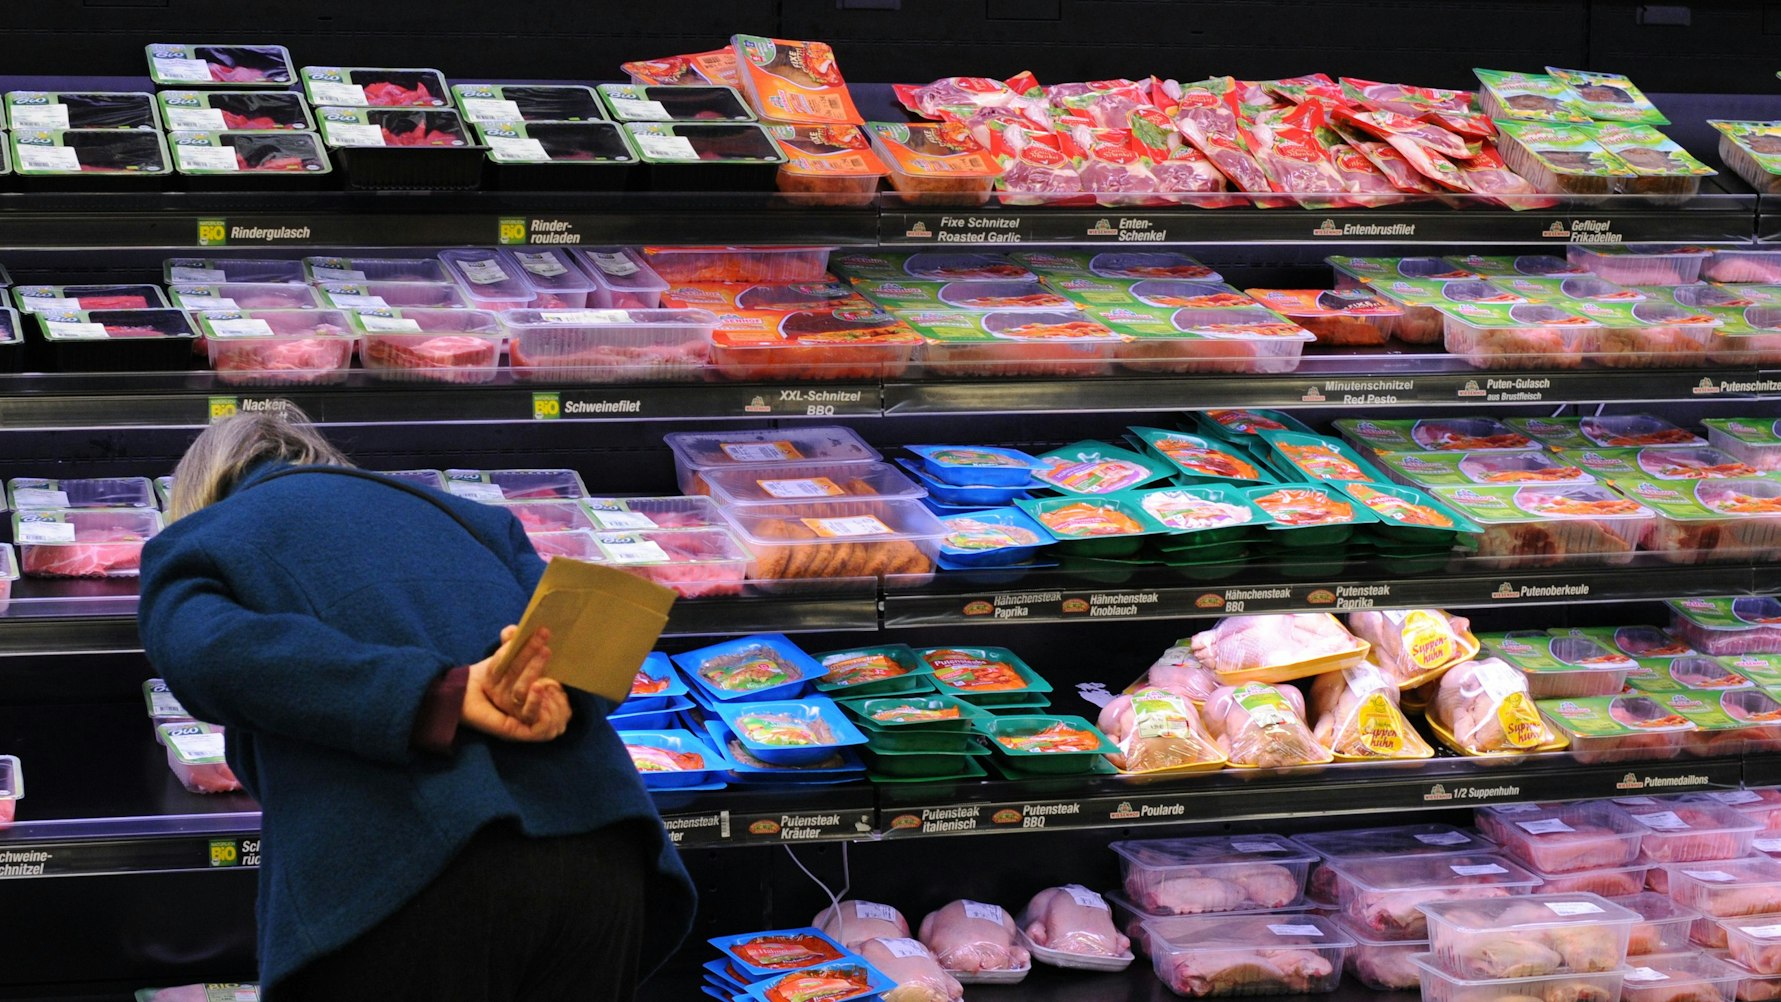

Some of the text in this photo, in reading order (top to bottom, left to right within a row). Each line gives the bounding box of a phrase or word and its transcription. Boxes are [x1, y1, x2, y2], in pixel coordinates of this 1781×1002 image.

[530, 220, 572, 231] Rinder-
[940, 217, 1020, 228] Fixe Schnitzel
[1119, 218, 1152, 229] Enten-
[1572, 220, 1611, 232] Geflügel
[231, 226, 310, 240] Rindergulasch
[1344, 224, 1416, 235] Entenbrustfilet
[530, 232, 580, 244] rouladen
[938, 231, 1020, 242] Roasted Garlic
[1118, 230, 1166, 242] Schenkel
[1570, 232, 1622, 242] Frikadellen
[1325, 380, 1414, 391] Minutenschnitzel
[1487, 378, 1550, 389] Puten-Gulasch
[780, 390, 861, 401] XXL-Schnitzel
[1344, 394, 1397, 404] Red Pesto
[1501, 392, 1542, 400] Brustfleisch
[242, 399, 291, 410] Nacken-
[564, 400, 641, 412] Schweinefilet
[806, 405, 834, 416] BBQ
[1225, 588, 1291, 600] Hähnchensteak
[1336, 585, 1390, 597] Putensteak
[1521, 584, 1590, 597] Putenoberkeule
[994, 592, 1062, 606] Hähnchensteak
[1090, 593, 1159, 604] Hähnchensteak
[1336, 597, 1374, 610] Paprika
[994, 606, 1028, 619] Paprika
[1090, 604, 1138, 616] Knoblauch
[1226, 602, 1244, 612] BBQ
[1424, 650, 1444, 664] huhn
[1371, 736, 1394, 748] huhn
[1644, 774, 1709, 787] Putenmedaillons
[1454, 786, 1520, 799] 1/2 Suppenhuhn
[922, 806, 980, 820] Putensteak
[1023, 803, 1080, 816] Putensteak
[1141, 803, 1184, 816] Poularde
[780, 814, 840, 827] Putensteak
[922, 818, 976, 832] italienisch
[1022, 816, 1045, 828] BBQ
[780, 827, 820, 839] Kräuter
